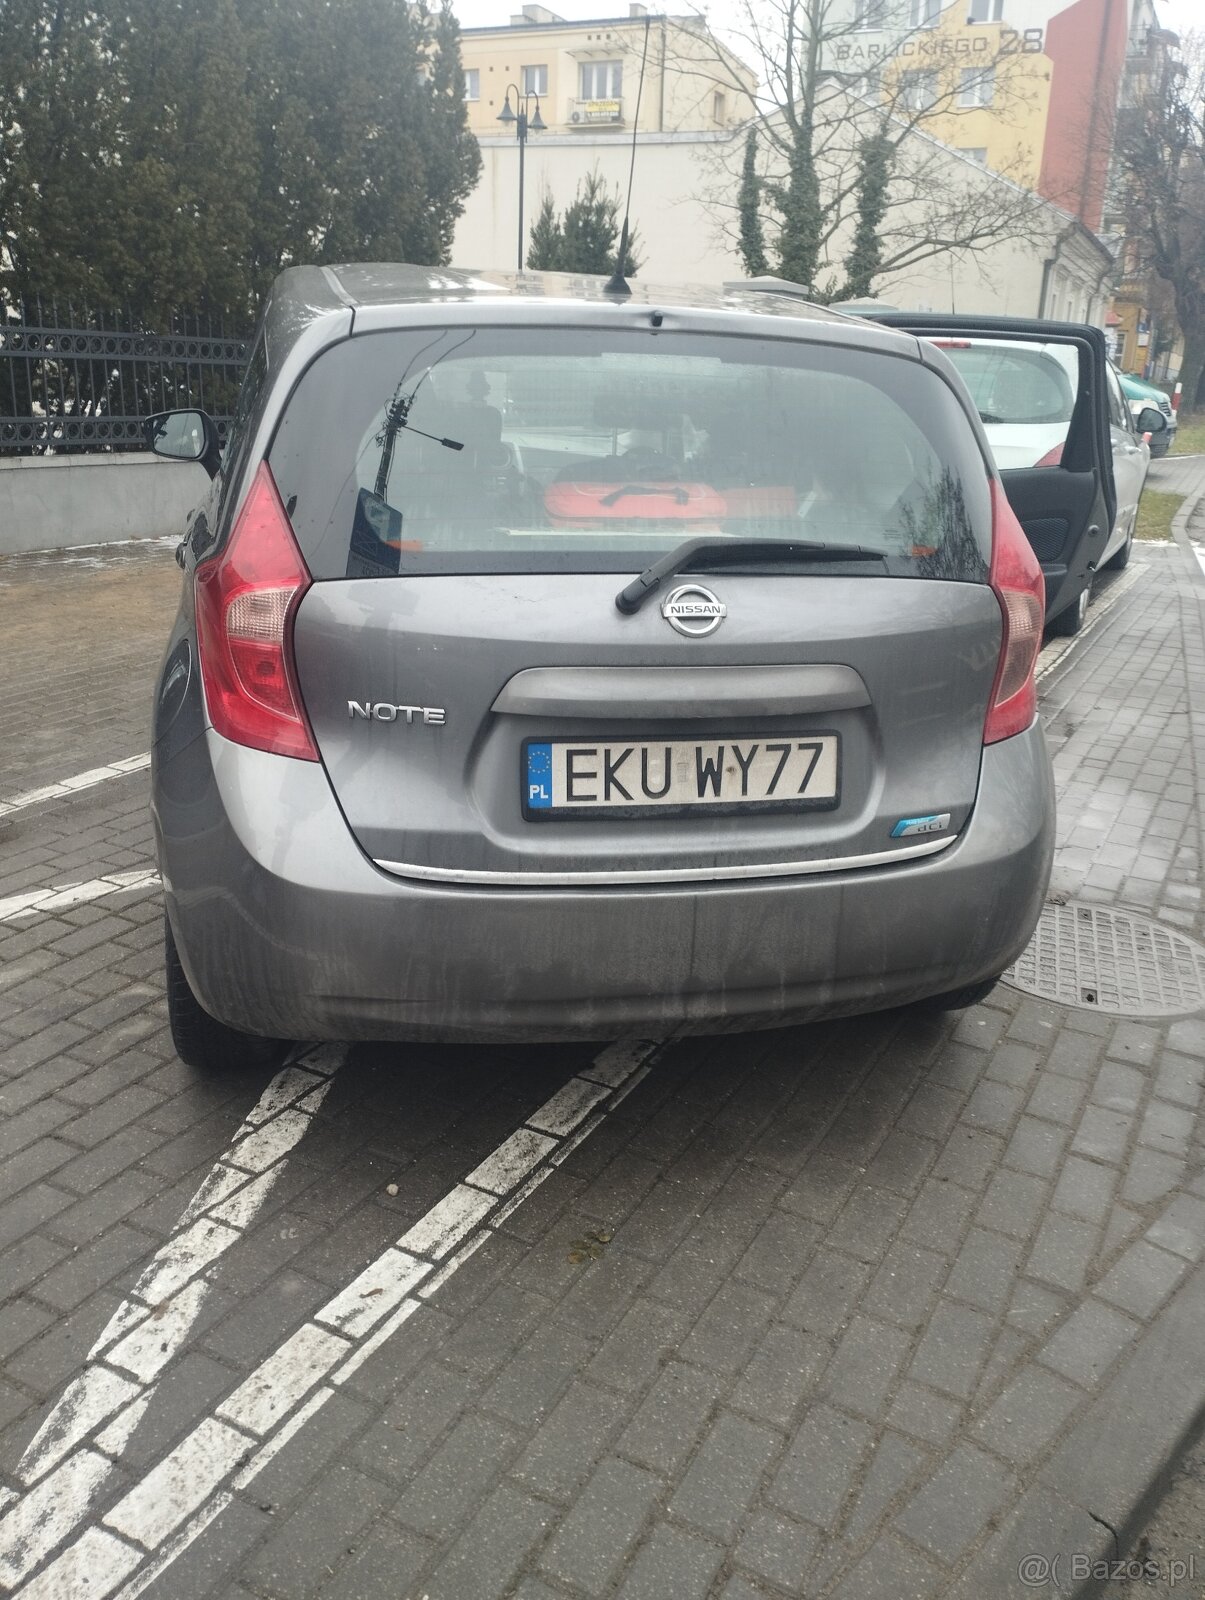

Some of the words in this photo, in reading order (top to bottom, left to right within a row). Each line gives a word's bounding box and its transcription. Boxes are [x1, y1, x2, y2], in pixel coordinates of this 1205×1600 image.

[836, 37, 988, 60] BARLICKIEGO
[1000, 28, 1043, 55] 28
[670, 605, 721, 614] NISSAN
[347, 700, 446, 725] NOTE
[566, 746, 672, 802] EKU
[695, 742, 824, 798] WY77
[529, 784, 549, 799] PL
